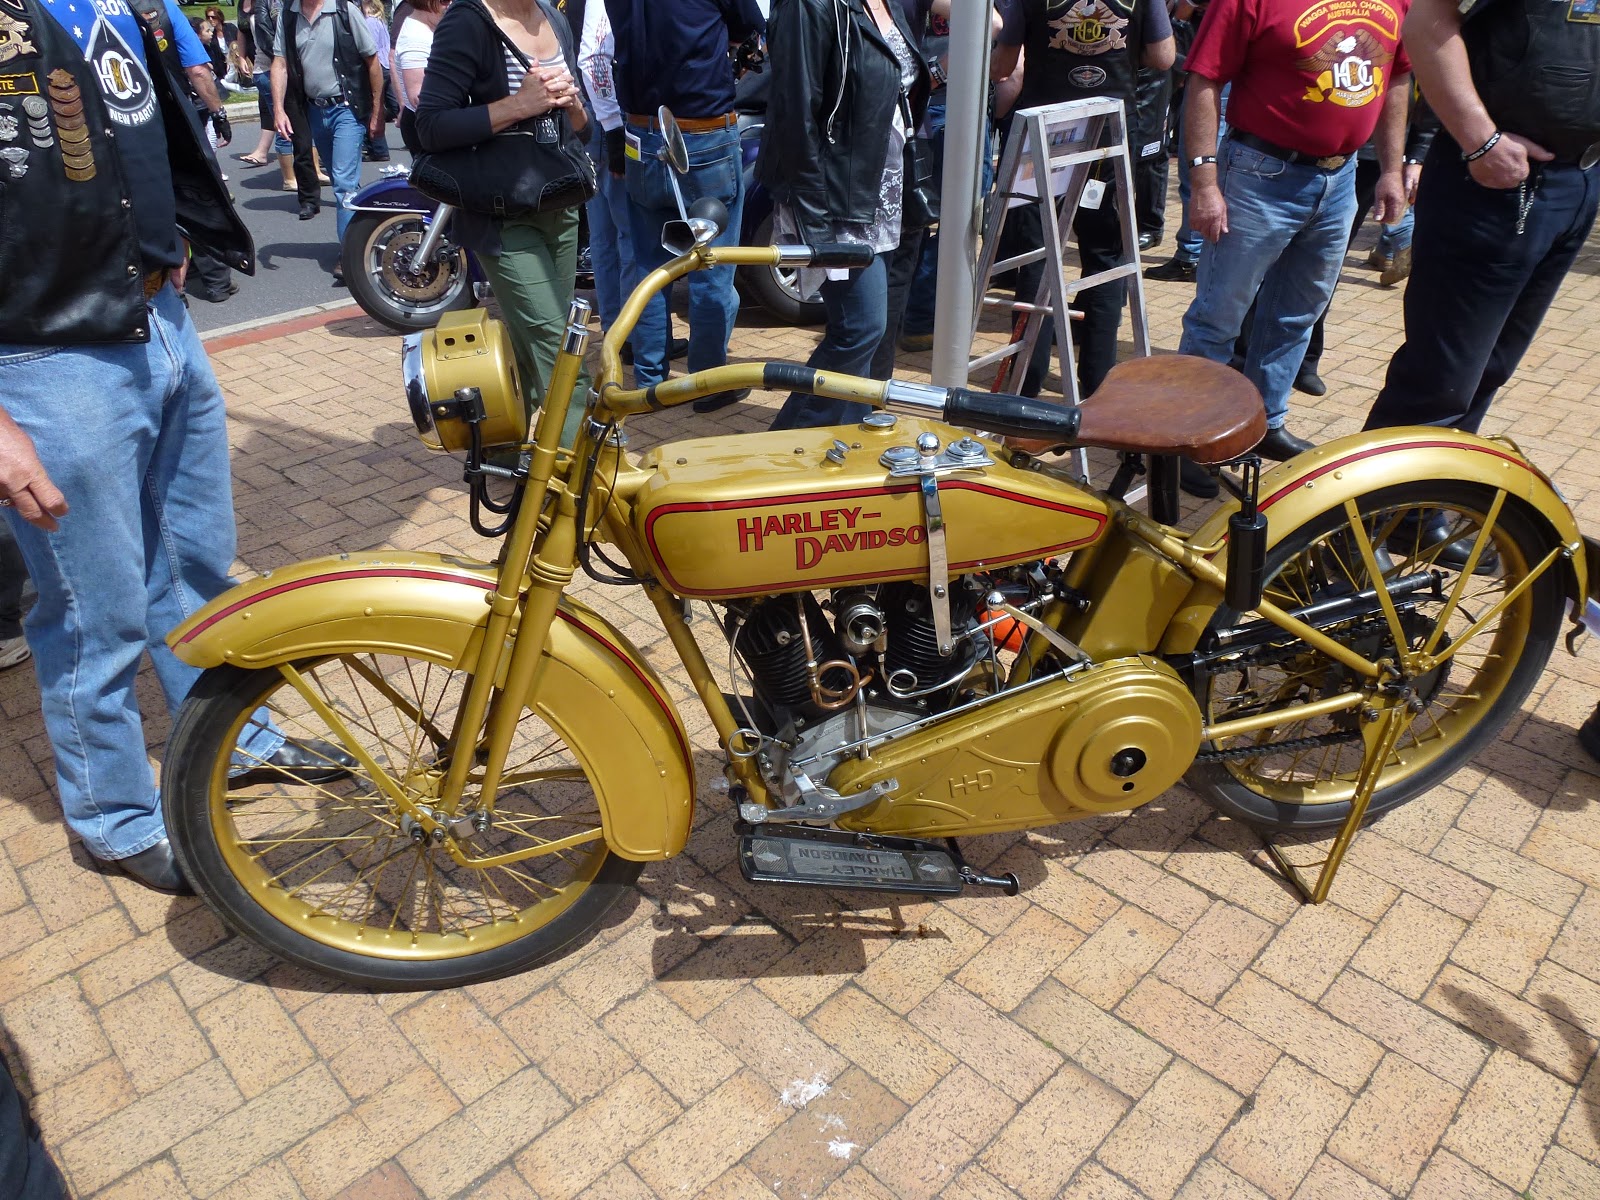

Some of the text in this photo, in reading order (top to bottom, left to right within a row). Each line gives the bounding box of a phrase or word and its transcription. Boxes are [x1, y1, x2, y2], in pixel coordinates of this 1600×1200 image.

[1300, 1, 1395, 28] WAGGA WAGGA CHAPTER
[1328, 8, 1371, 20] AUSTRALIA
[109, 100, 155, 125] NEW PARTY
[737, 507, 881, 552] HARLEY-
[796, 523, 946, 570] DAVIDSO
[948, 769, 995, 799] H-D
[798, 847, 880, 864] DAVIDSON
